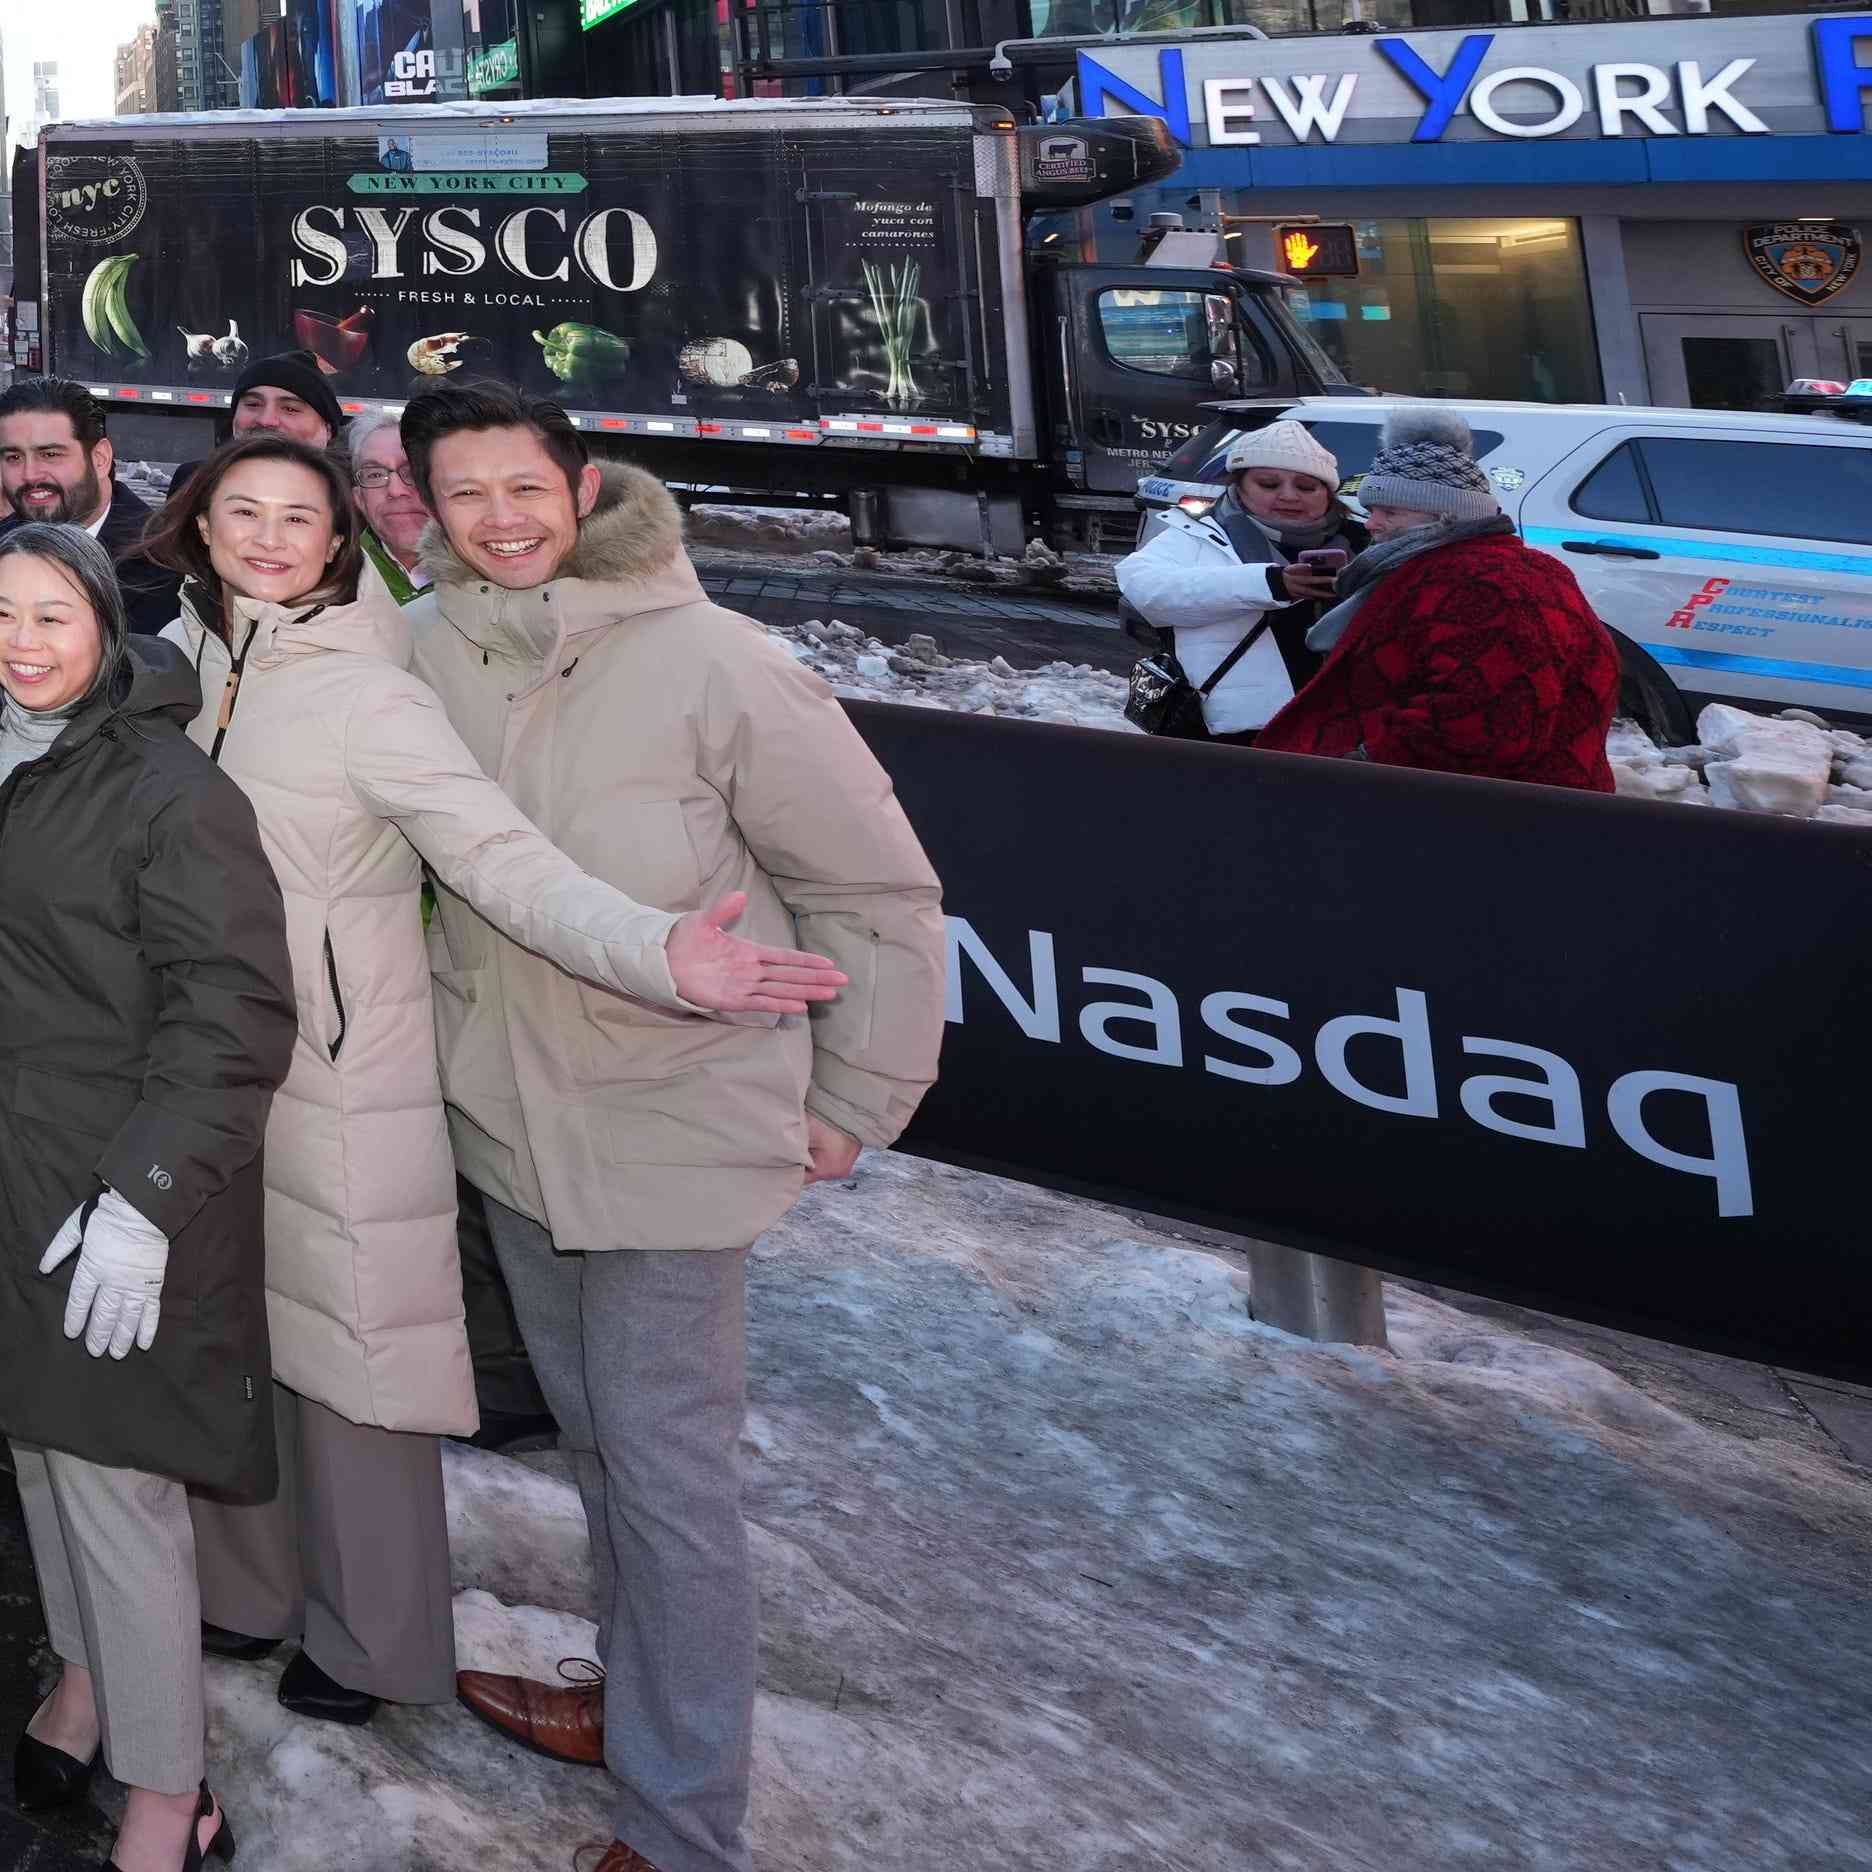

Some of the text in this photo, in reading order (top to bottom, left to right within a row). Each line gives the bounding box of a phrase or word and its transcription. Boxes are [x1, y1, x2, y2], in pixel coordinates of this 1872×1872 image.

[1076, 47, 1358, 149] NEW
[1375, 33, 1771, 144] YORK
[366, 175, 568, 190] NEW YORK CITY
[61, 178, 121, 212] nyc
[853, 201, 933, 215] Mofongo de
[871, 216, 934, 228] yuca con
[861, 229, 936, 240] camarones
[1753, 232, 1854, 248] DEPARTMENT
[290, 204, 658, 293] SYSCO
[398, 290, 546, 307] FRESH & LOCAL
[1140, 420, 1207, 440] SYSC
[1106, 446, 1150, 459] METRO
[1701, 577, 1825, 605] COURTESY
[1664, 609, 1776, 638] RESPECT
[942, 913, 1754, 1220] Nasdaq
